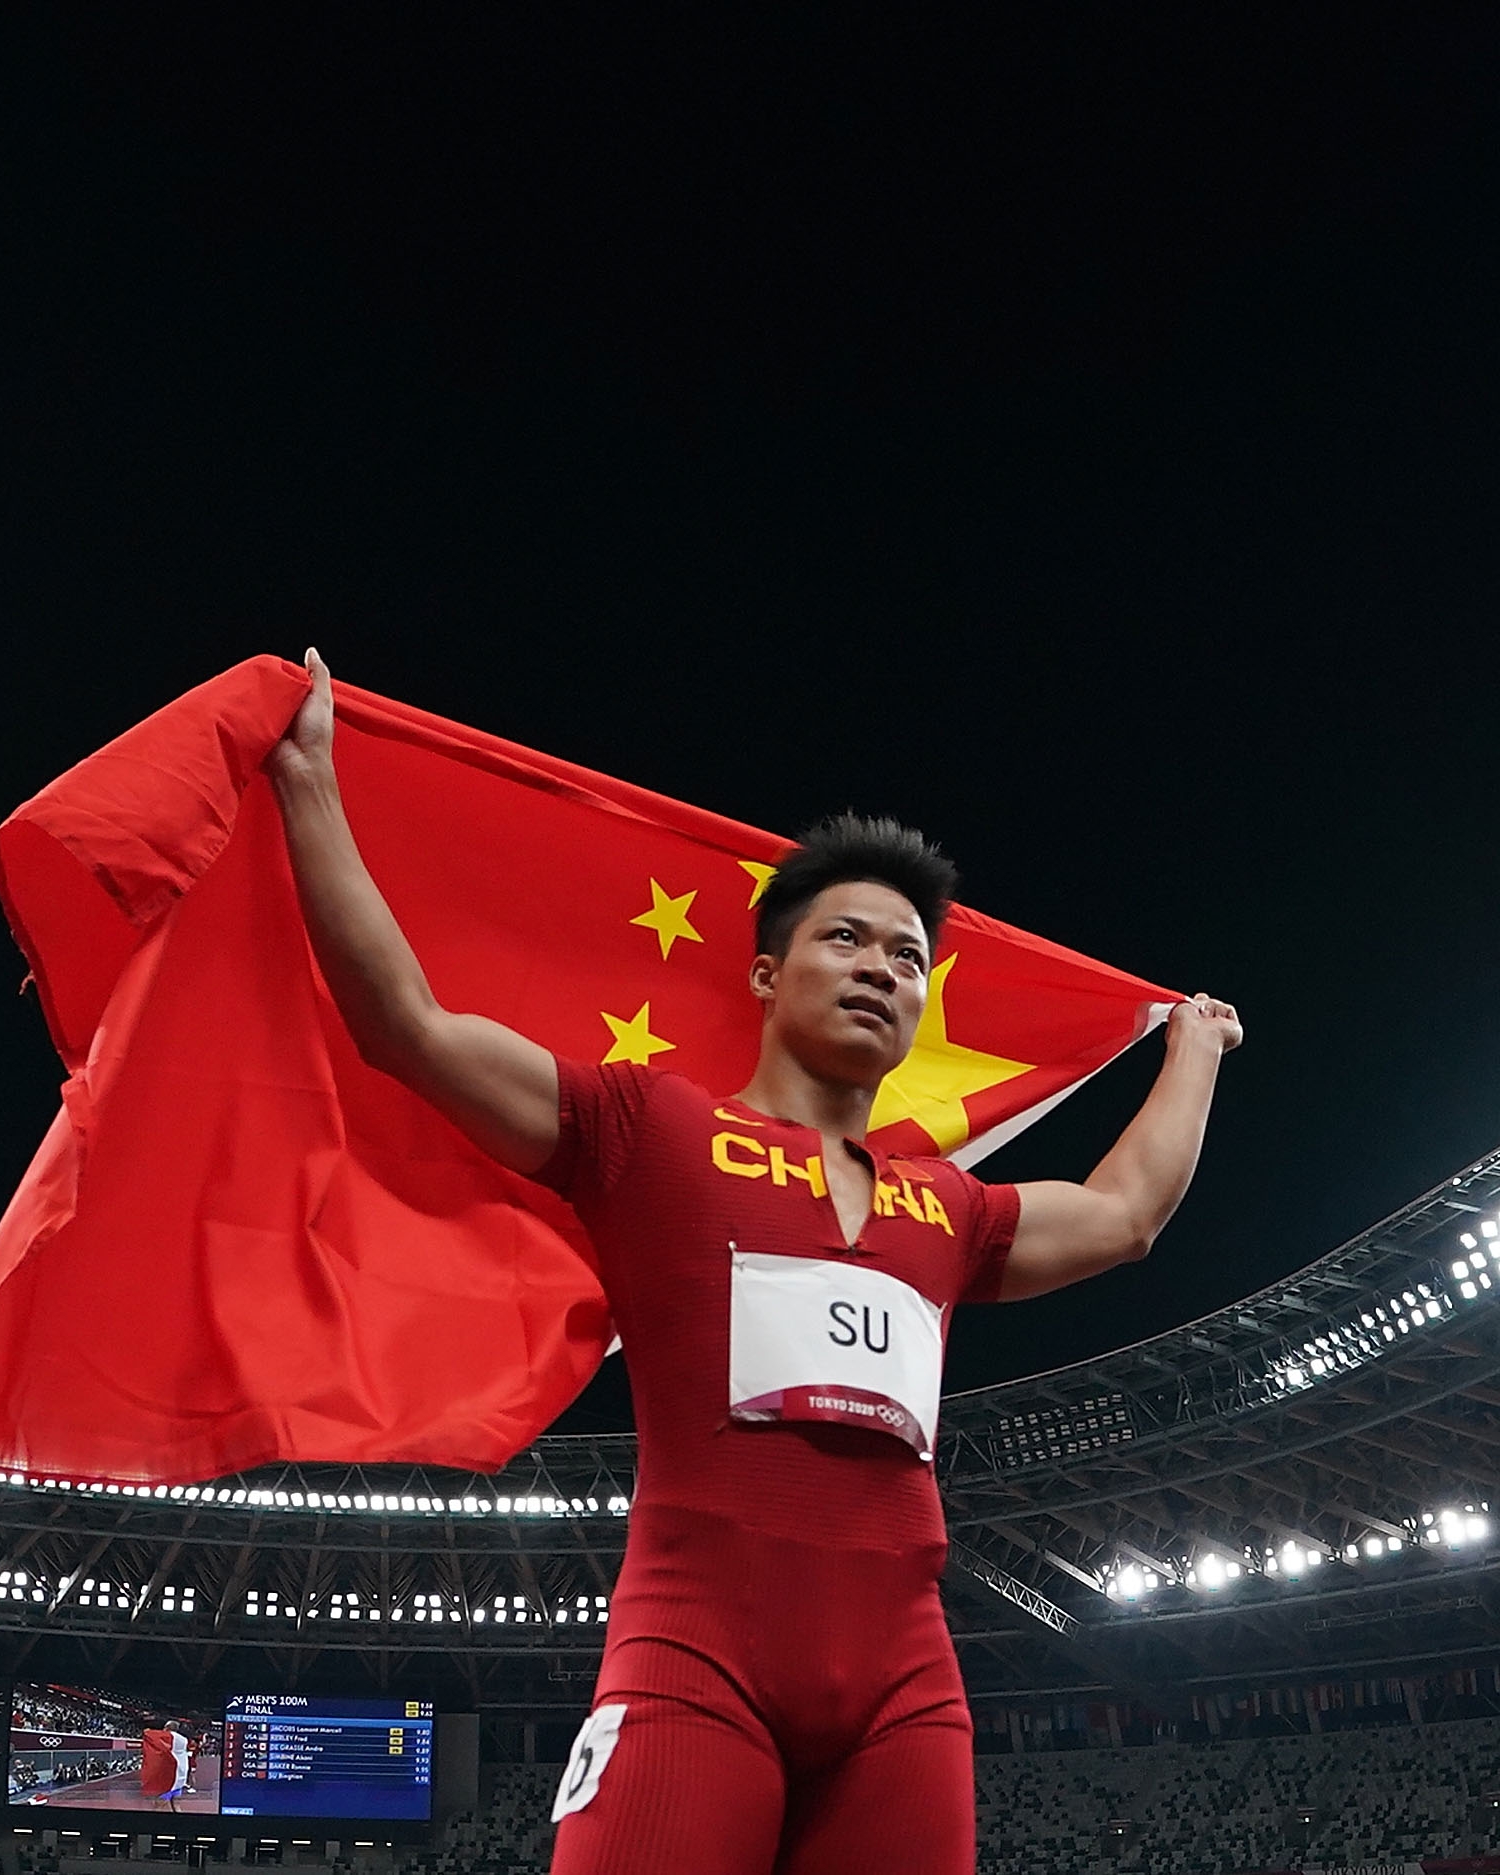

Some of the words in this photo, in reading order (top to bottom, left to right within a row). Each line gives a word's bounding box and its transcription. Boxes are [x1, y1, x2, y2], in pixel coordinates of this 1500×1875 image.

[828, 1301, 889, 1354] SU
[808, 1396, 847, 1411] TOKYO
[848, 1401, 875, 1416] 2020
[245, 1695, 277, 1705] MEN'S
[279, 1696, 308, 1706] 100M
[245, 1705, 273, 1715] FINAL
